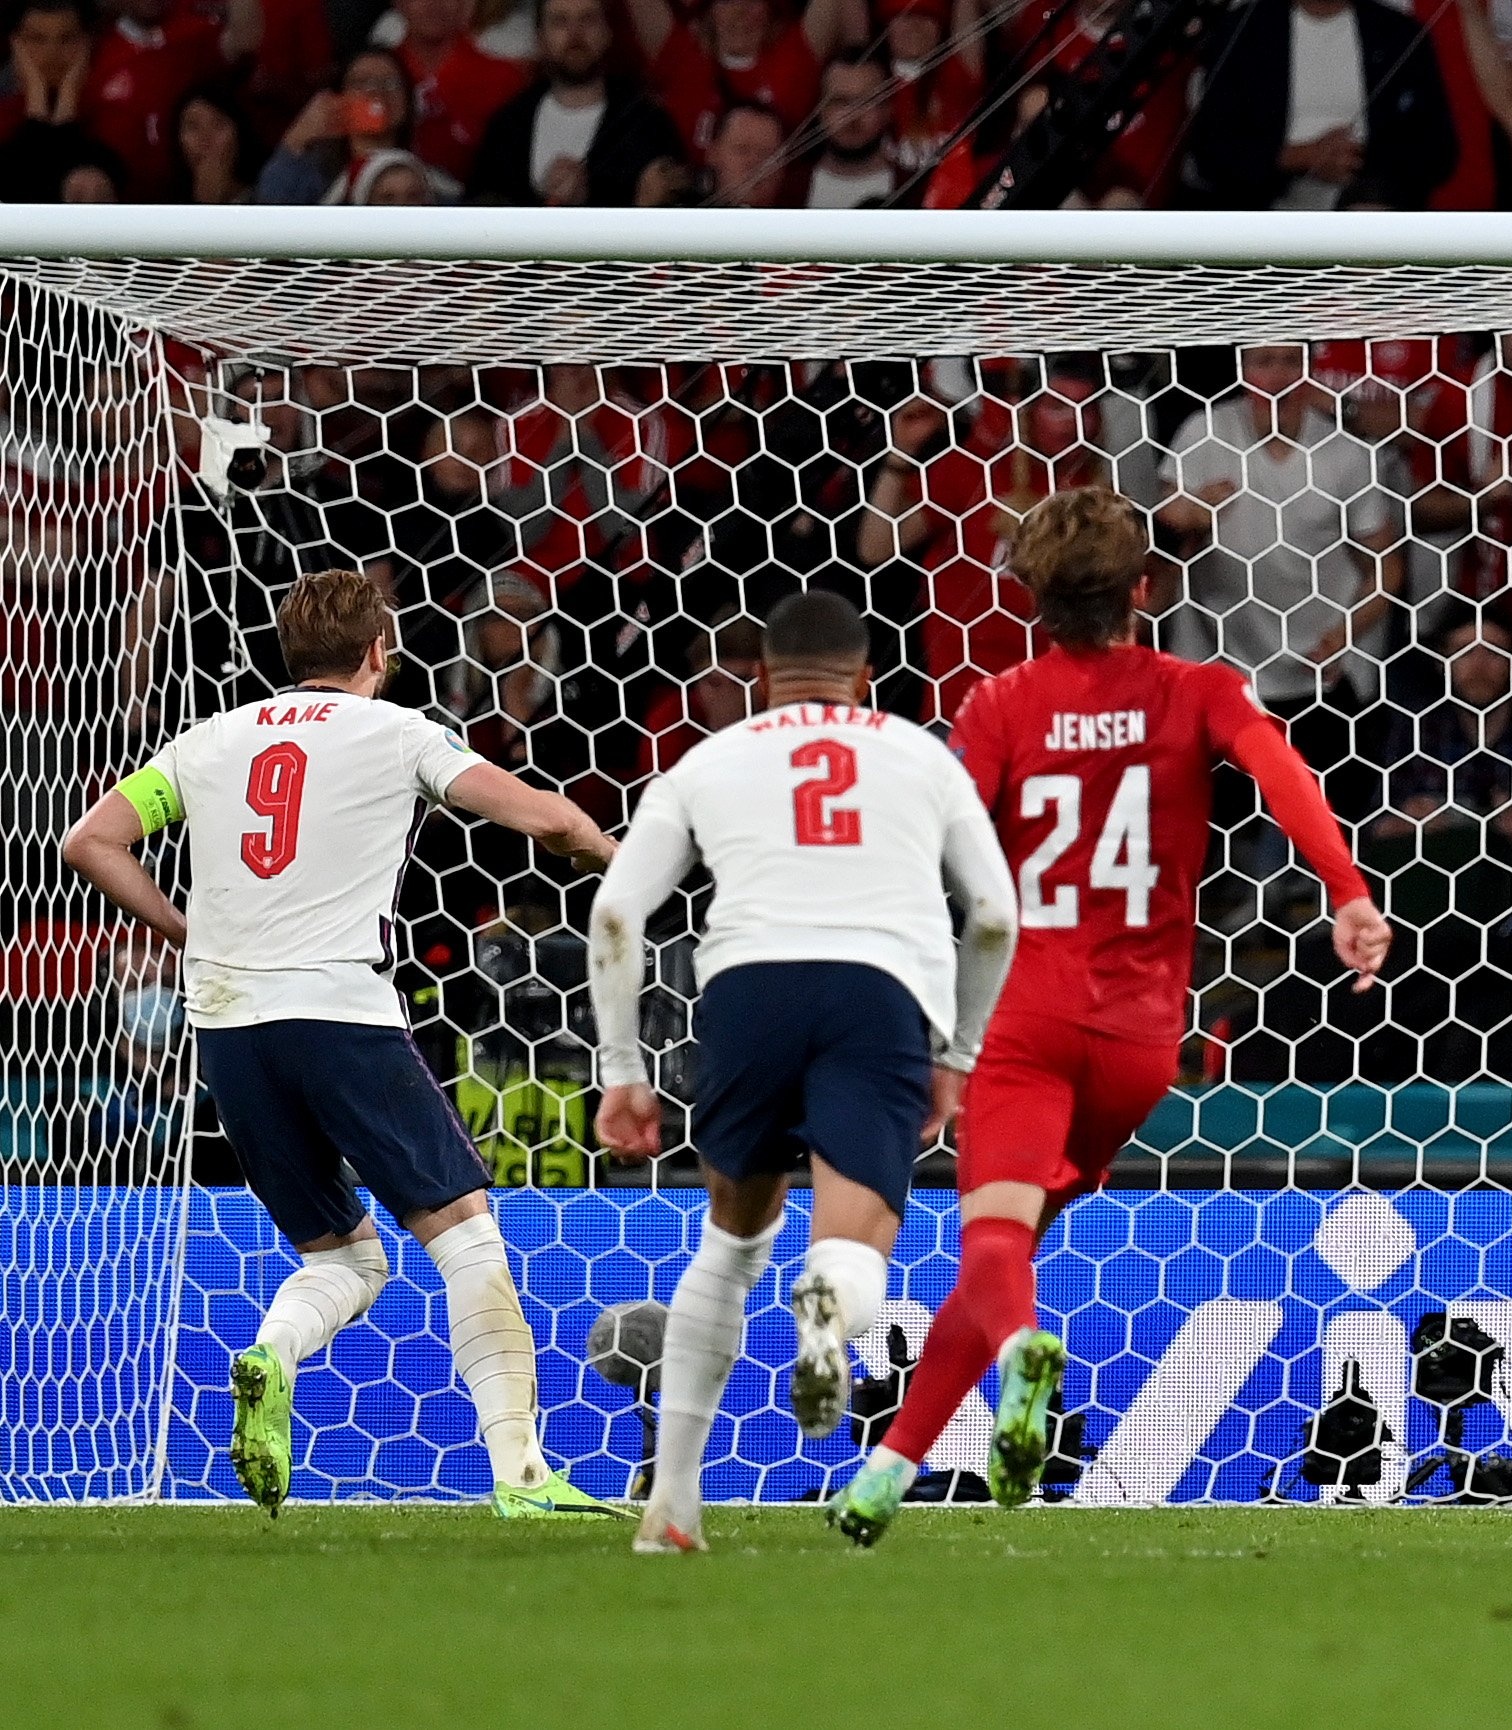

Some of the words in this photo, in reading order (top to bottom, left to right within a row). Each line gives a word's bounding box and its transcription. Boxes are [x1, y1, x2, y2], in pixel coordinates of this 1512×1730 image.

[256, 703, 339, 726] KANE
[1045, 709, 1146, 749] JENSEN
[241, 741, 308, 879] 9
[790, 739, 863, 846] 2
[1019, 764, 1161, 929] 24
